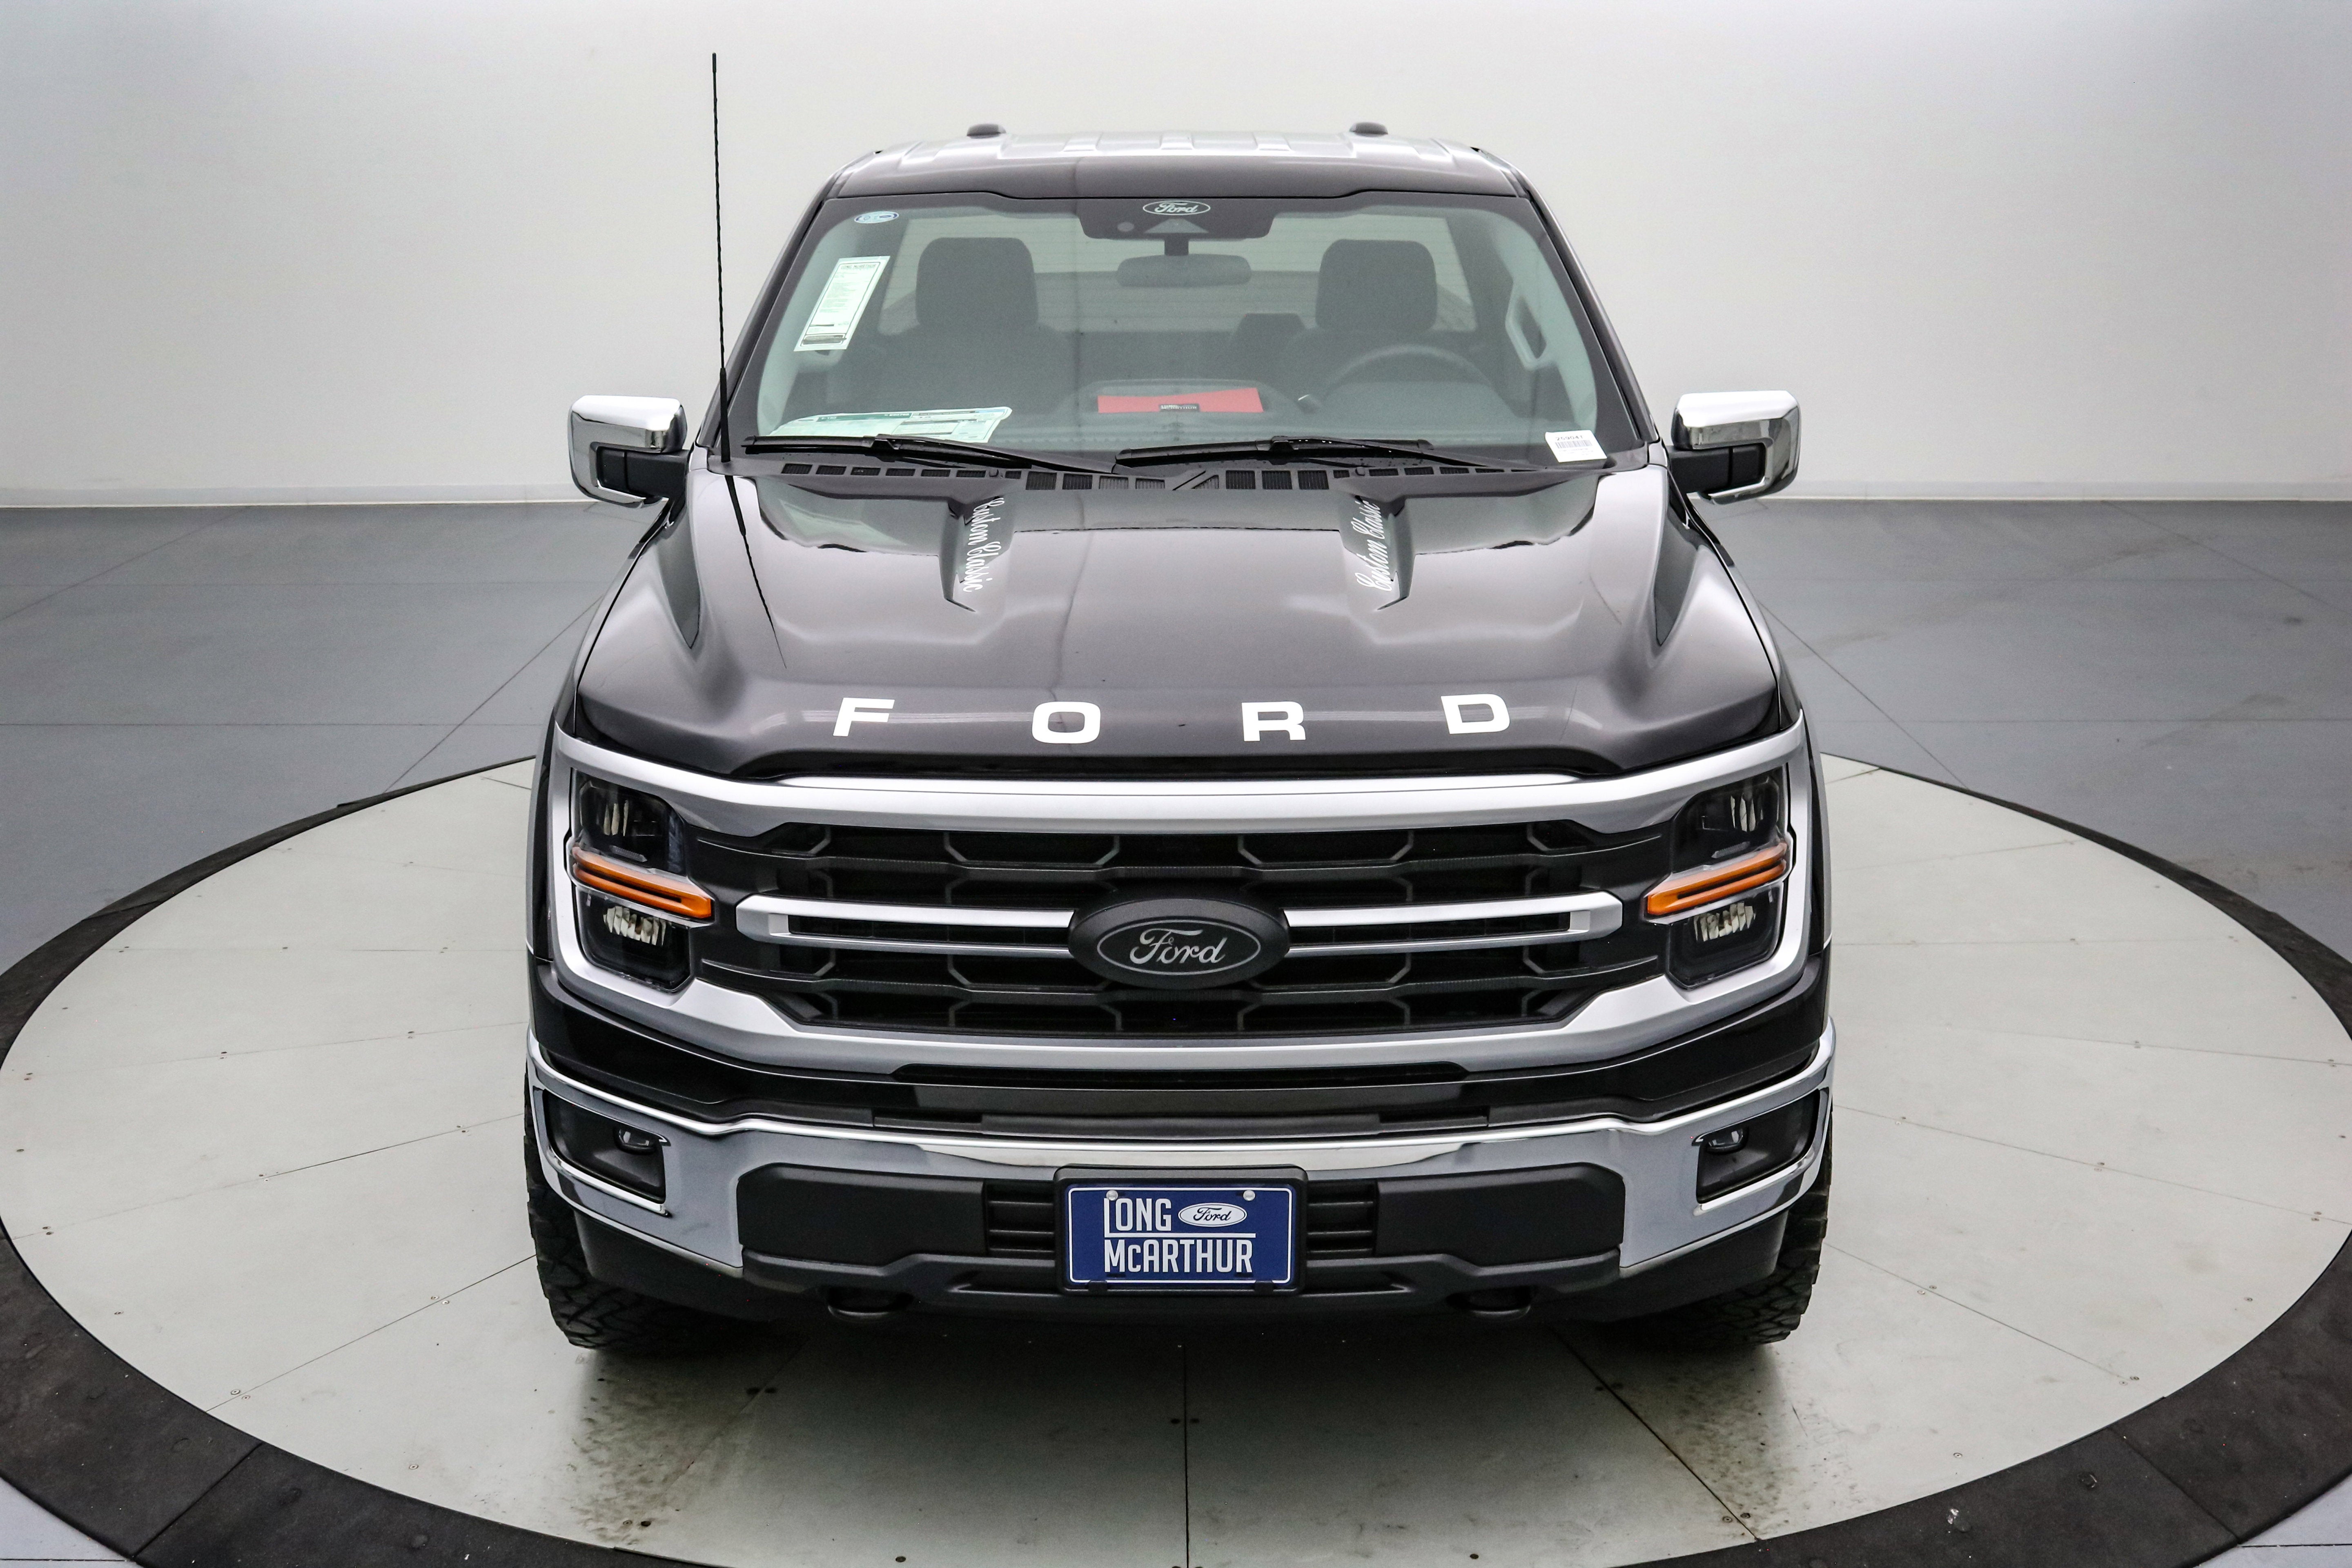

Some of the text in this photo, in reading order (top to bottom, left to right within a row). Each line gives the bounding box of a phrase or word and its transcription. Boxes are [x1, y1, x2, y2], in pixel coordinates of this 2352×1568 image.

[1154, 202, 1199, 213] Ford
[963, 497, 1004, 592] Custom Classic
[1351, 500, 1392, 592] Custom Classic
[1129, 928, 1227, 964] Ford
[1104, 1198, 1172, 1235] LONG
[1193, 1207, 1232, 1221] Ford
[1105, 1239, 1252, 1273] McARTHUR
